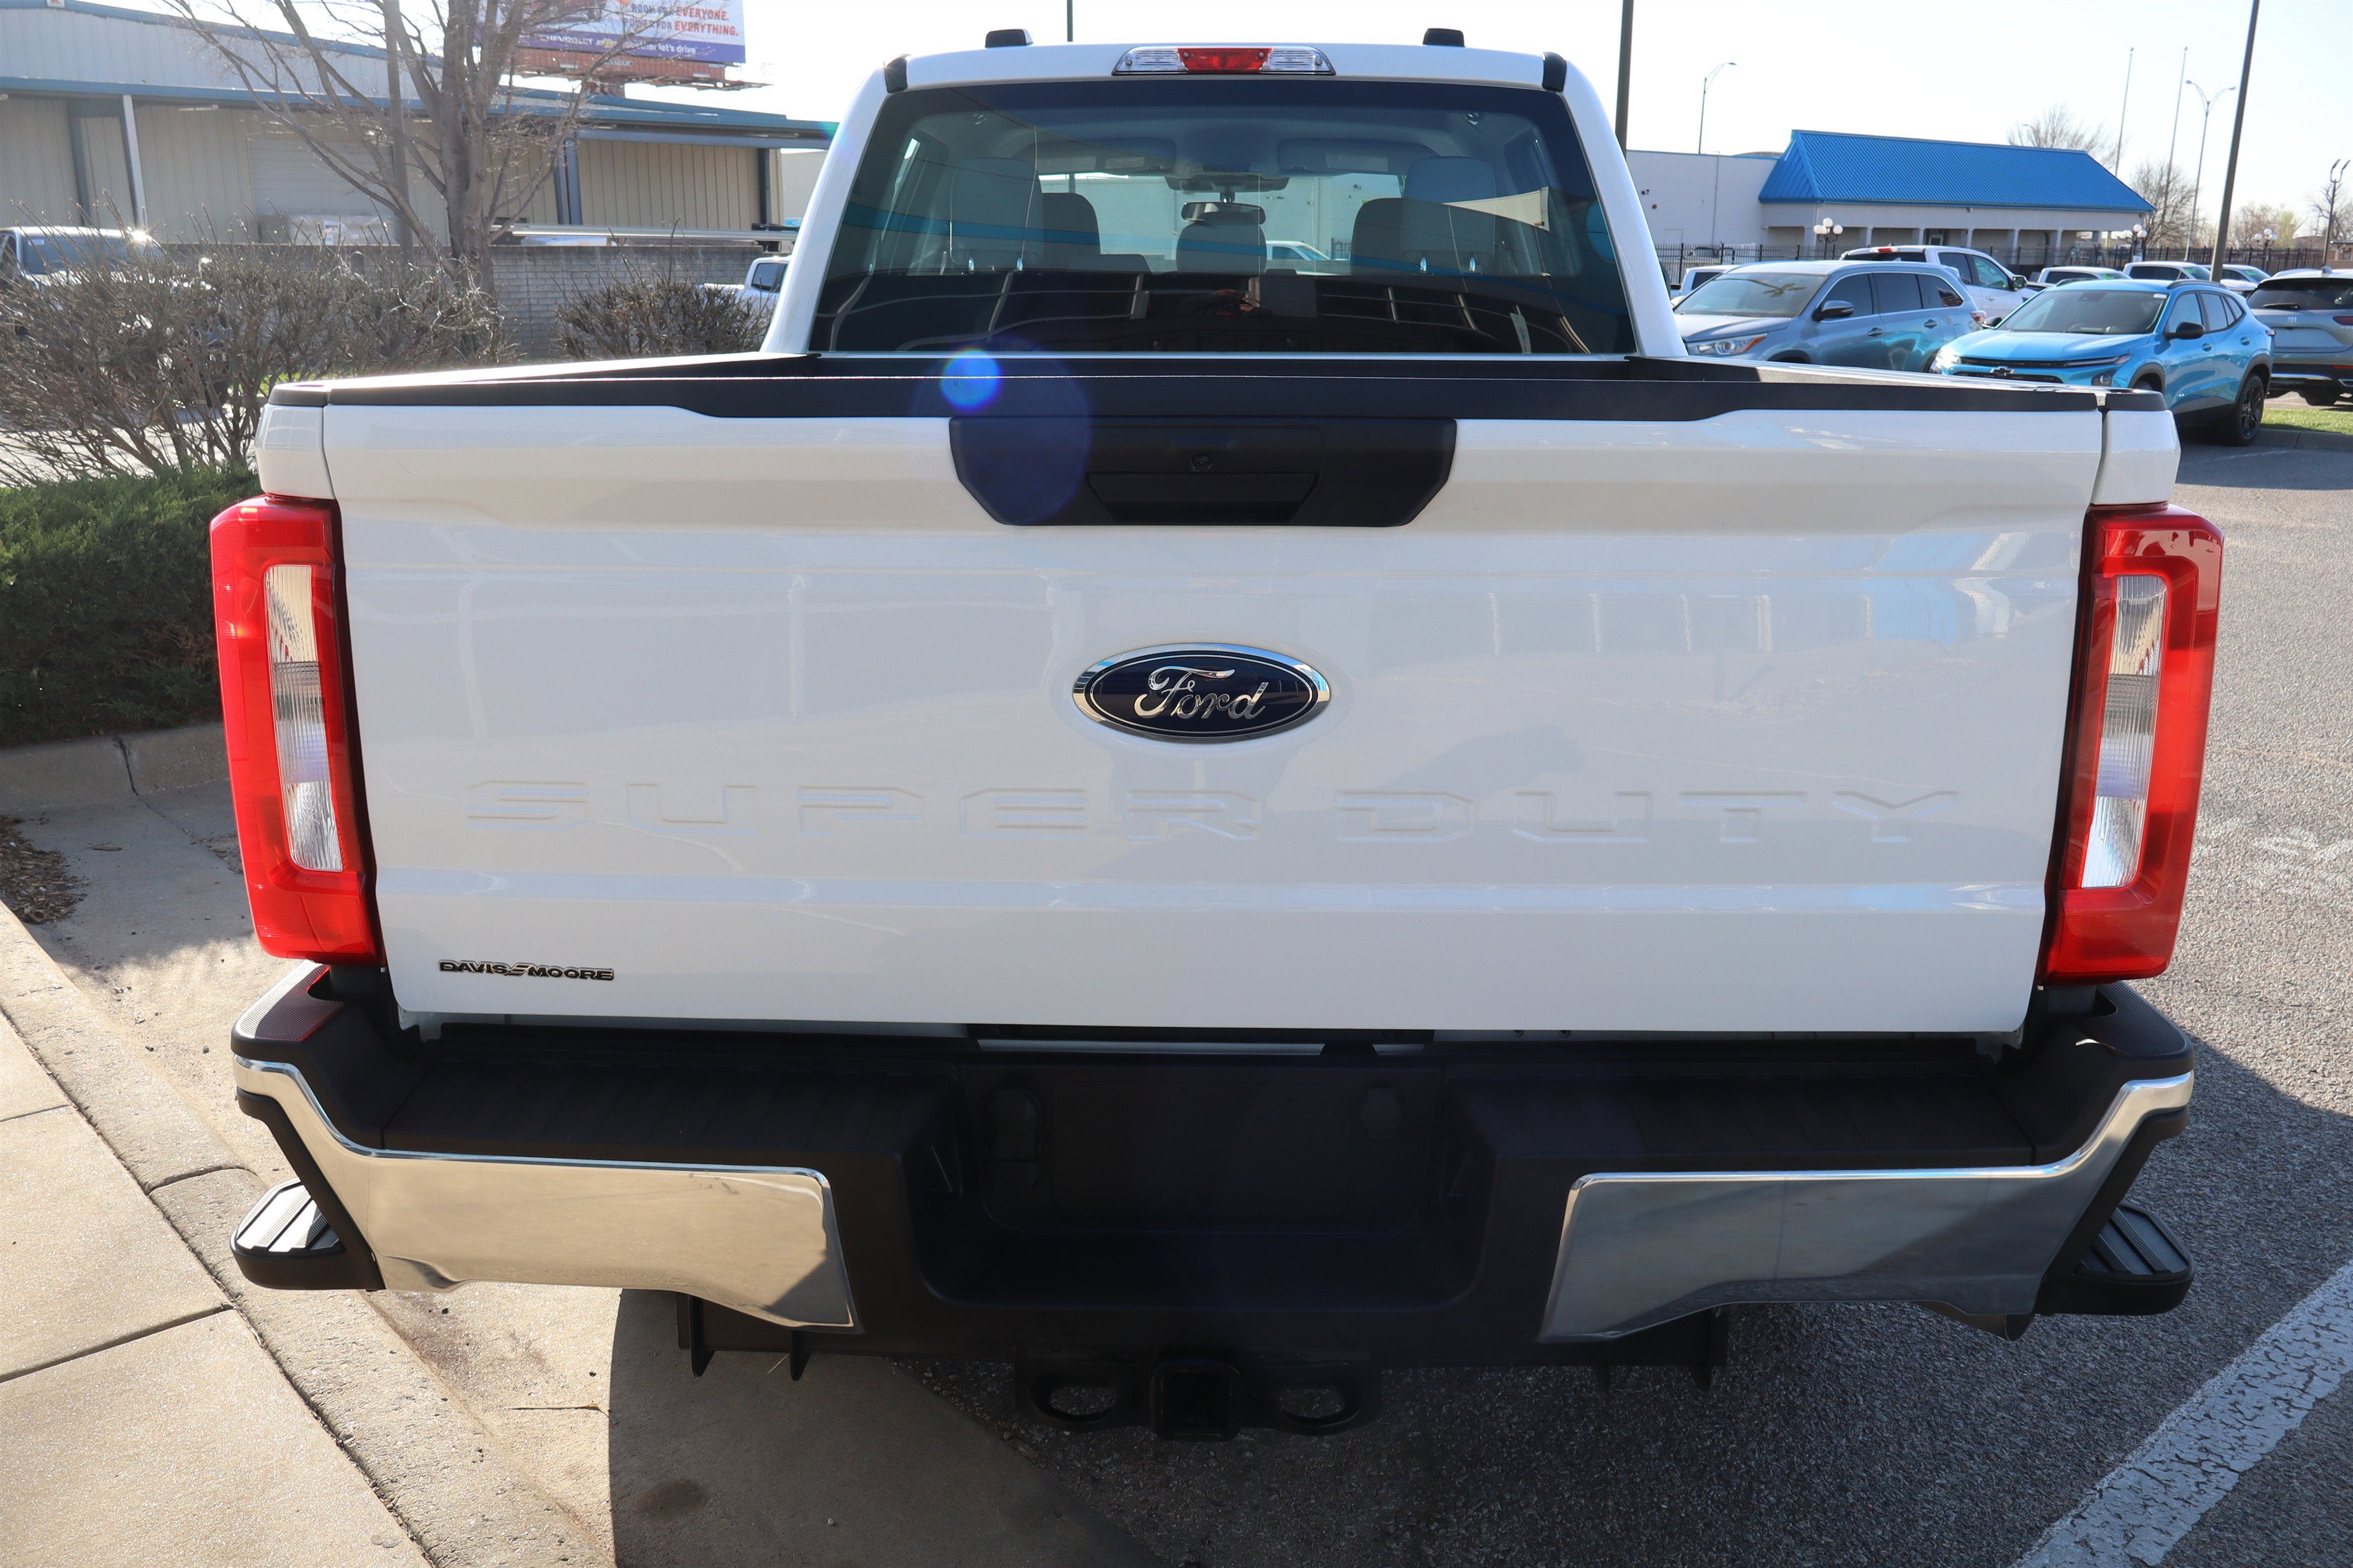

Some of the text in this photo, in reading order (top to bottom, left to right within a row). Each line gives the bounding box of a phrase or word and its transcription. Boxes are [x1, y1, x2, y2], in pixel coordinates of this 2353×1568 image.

[631, 3, 655, 13] ROOM
[676, 6, 730, 21] EVERYONE.
[656, 21, 673, 30] FOR
[674, 20, 739, 36] EVERYTHING.
[658, 43, 675, 52] let's
[1133, 665, 1269, 719] Ford
[465, 780, 1960, 844] SUPER DUTY
